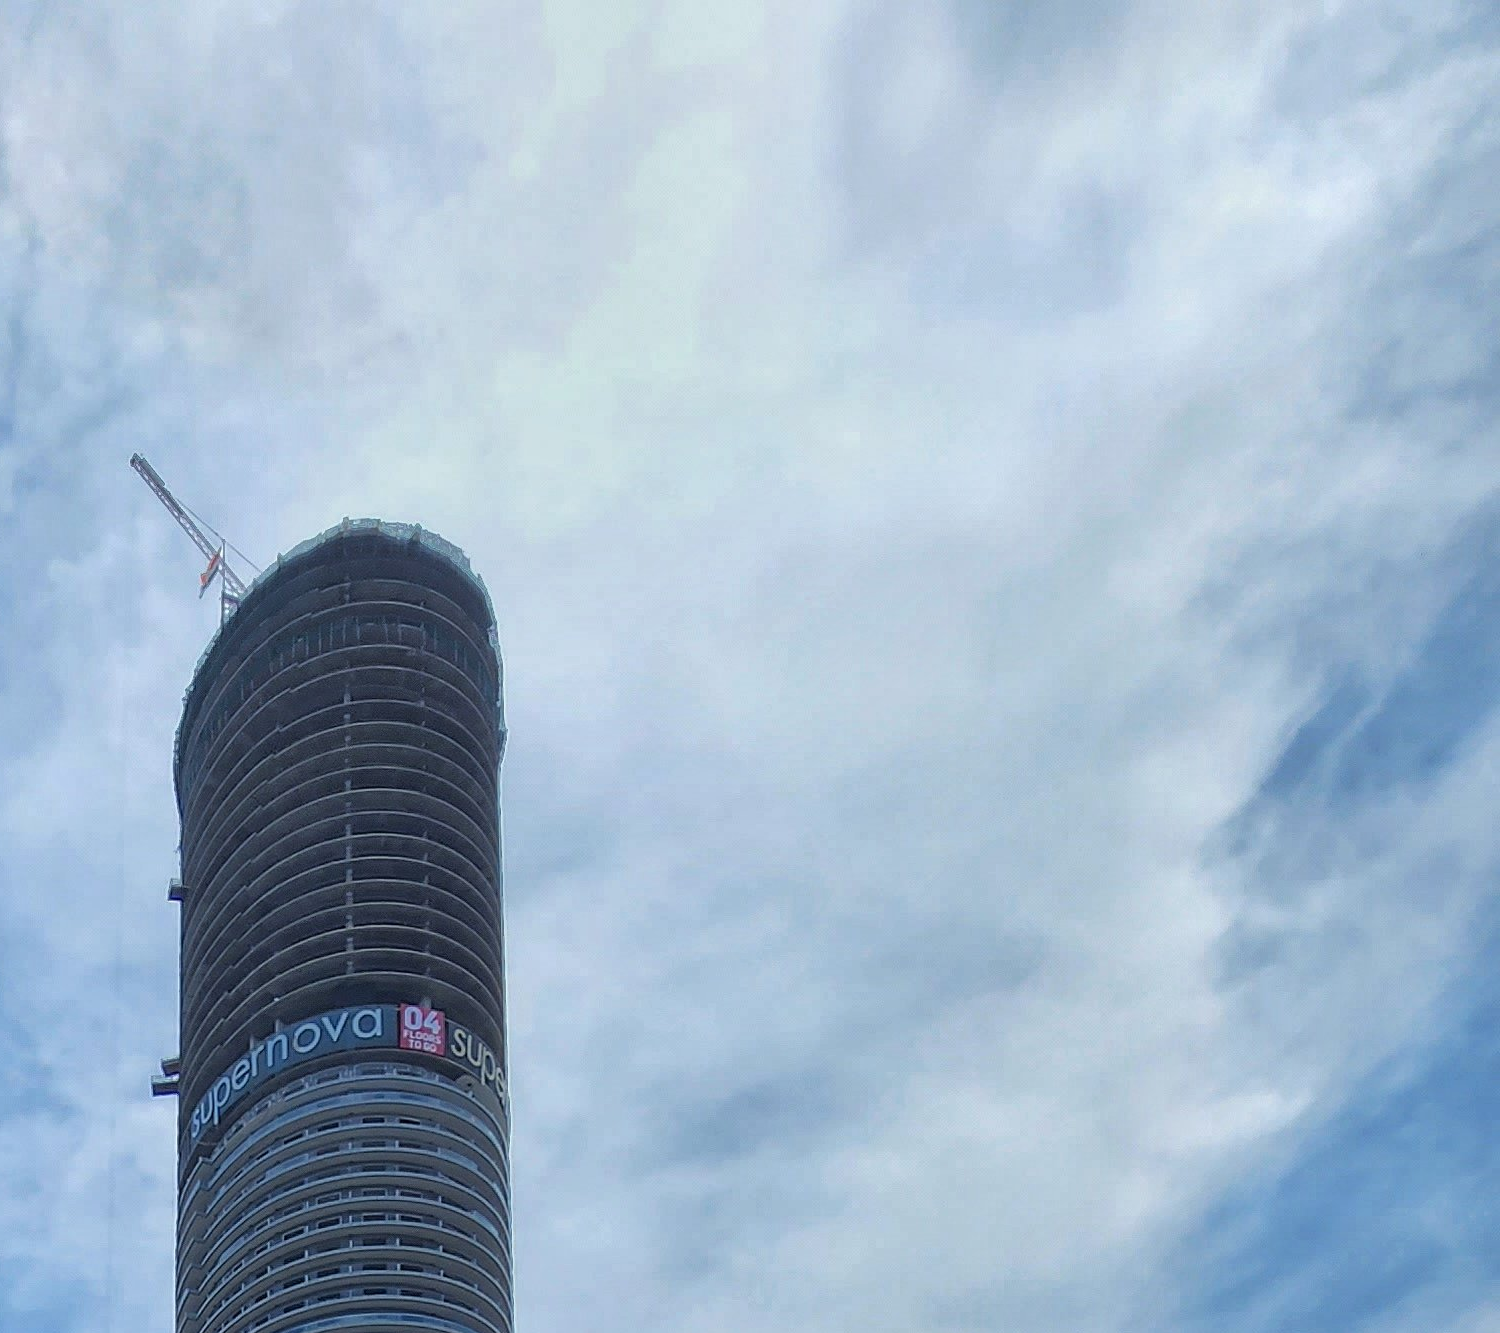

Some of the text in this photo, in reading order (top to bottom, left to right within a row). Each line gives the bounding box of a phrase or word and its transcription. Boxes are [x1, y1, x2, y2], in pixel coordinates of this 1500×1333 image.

[404, 1006, 441, 1034] 04
[402, 1029, 442, 1045] FLOORS
[409, 1039, 437, 1053] TO GO
[191, 1007, 382, 1139] supernova
[450, 1028, 504, 1104] supe
